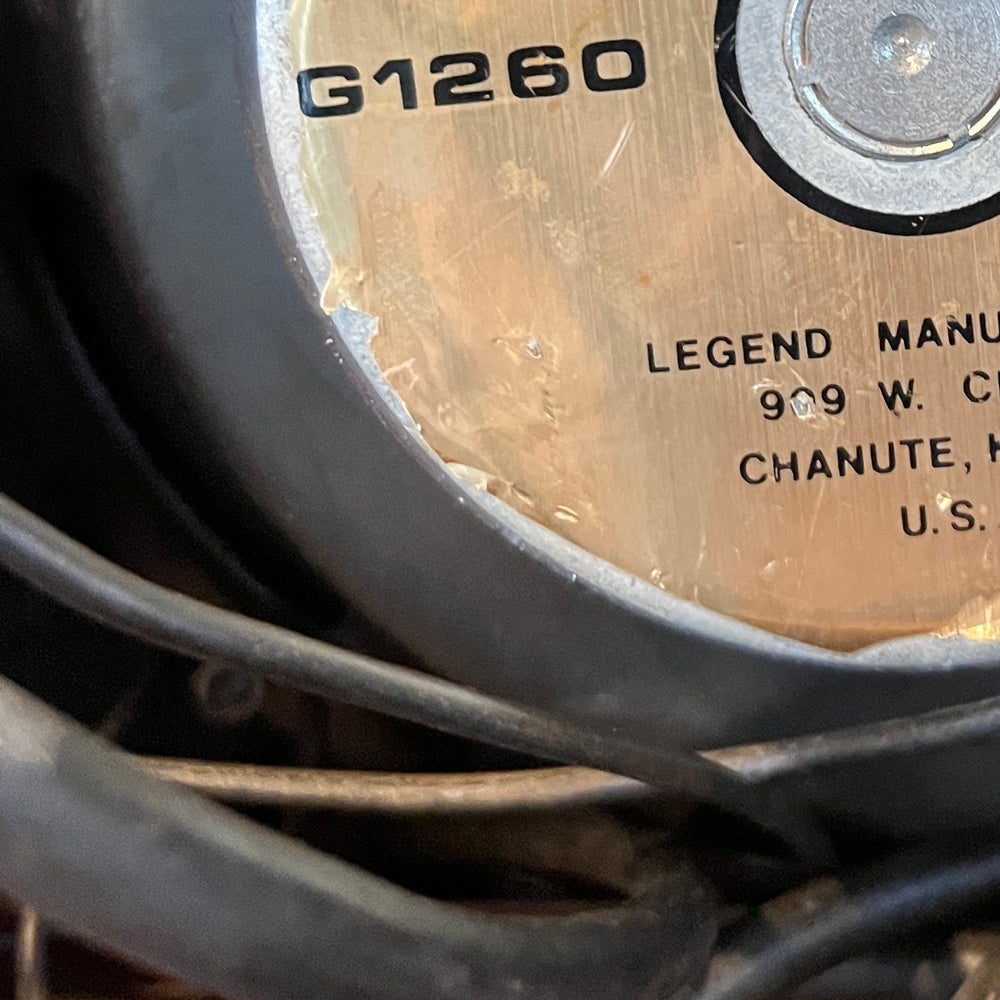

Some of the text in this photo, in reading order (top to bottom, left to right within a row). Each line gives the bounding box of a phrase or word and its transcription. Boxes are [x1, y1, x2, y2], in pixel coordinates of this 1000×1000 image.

[296, 38, 647, 118] G1260
[646, 328, 833, 373] LEGEND
[877, 378, 924, 413] W.
[739, 437, 972, 486] CHANUTE,
